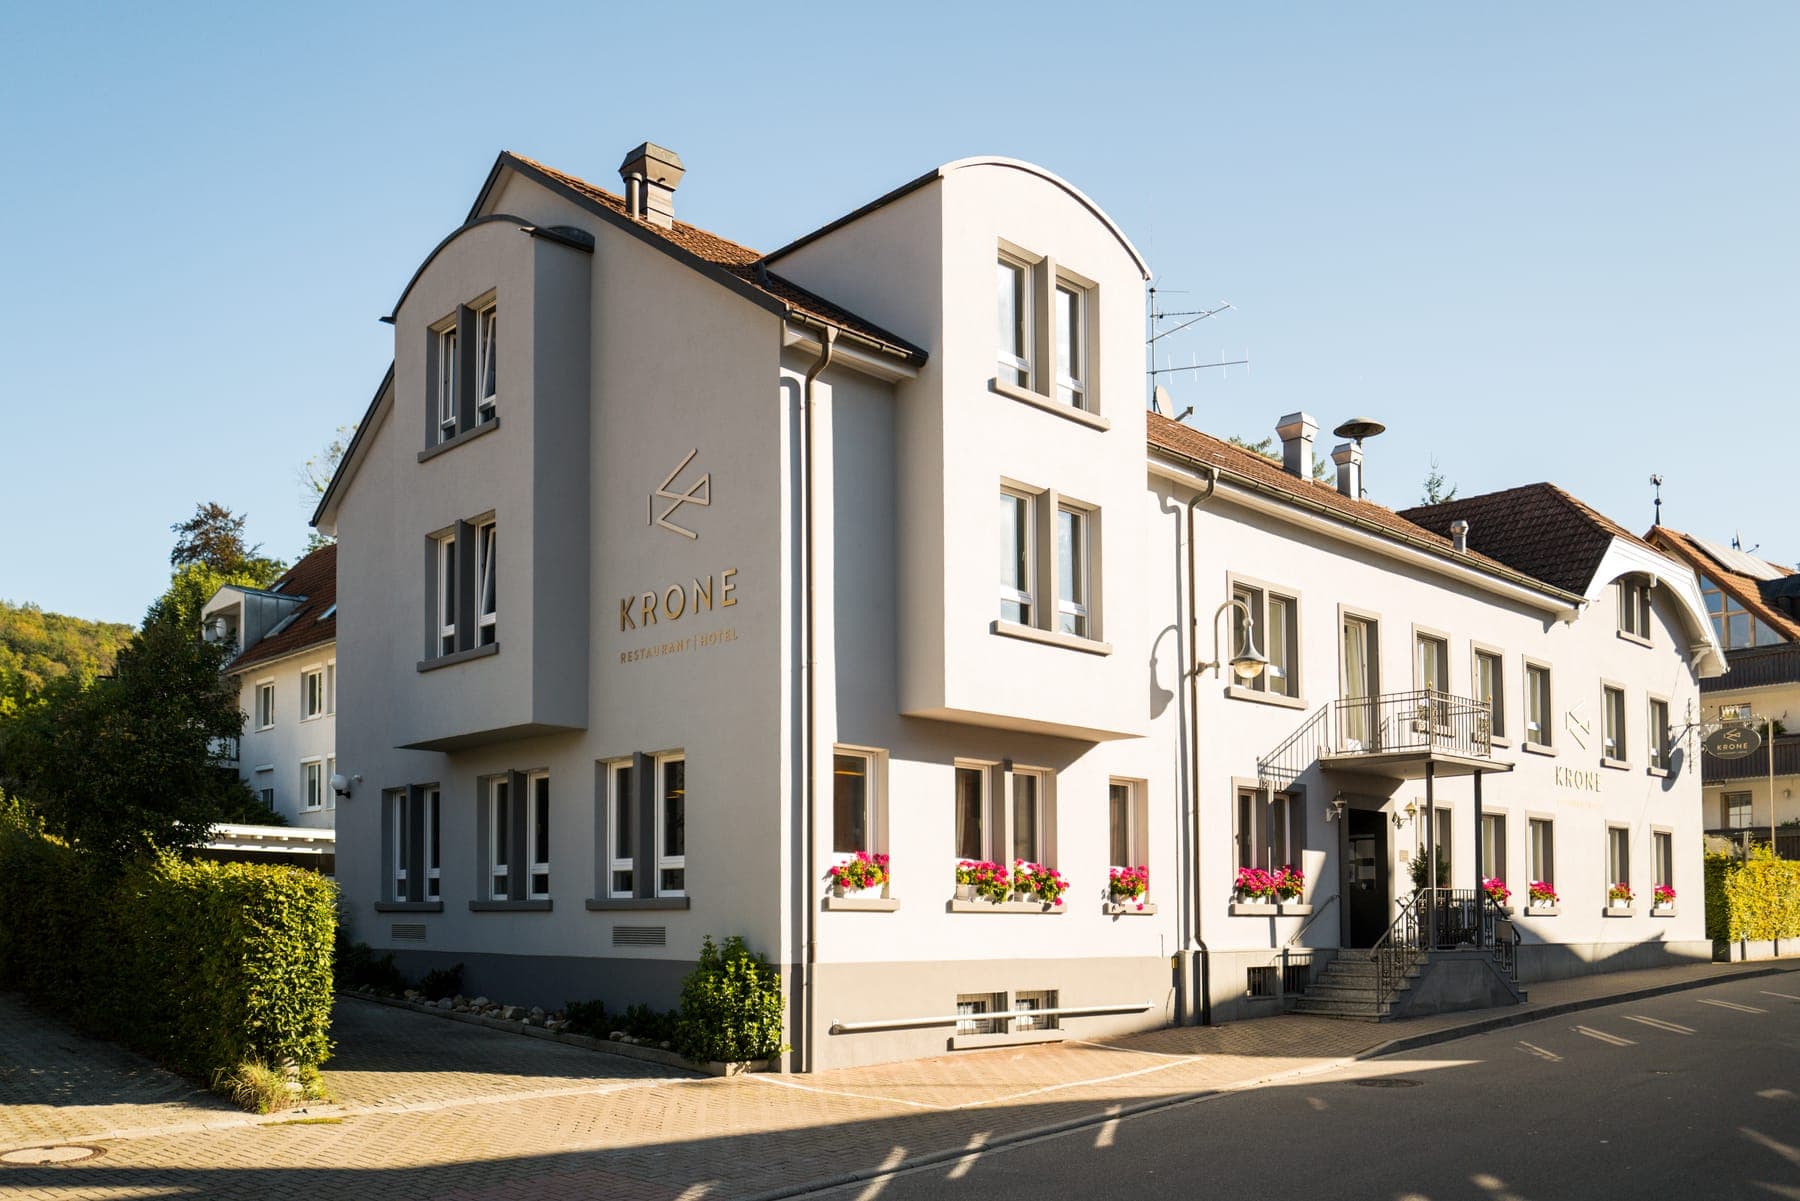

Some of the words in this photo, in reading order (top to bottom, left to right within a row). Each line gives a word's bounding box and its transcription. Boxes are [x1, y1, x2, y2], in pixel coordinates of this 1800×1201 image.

[620, 568, 738, 632] KRONE
[620, 639, 689, 664] RESTAURANT
[701, 628, 738, 647] HOTEL
[1716, 742, 1749, 751] KRONE
[1555, 766, 1601, 793] KRONE
